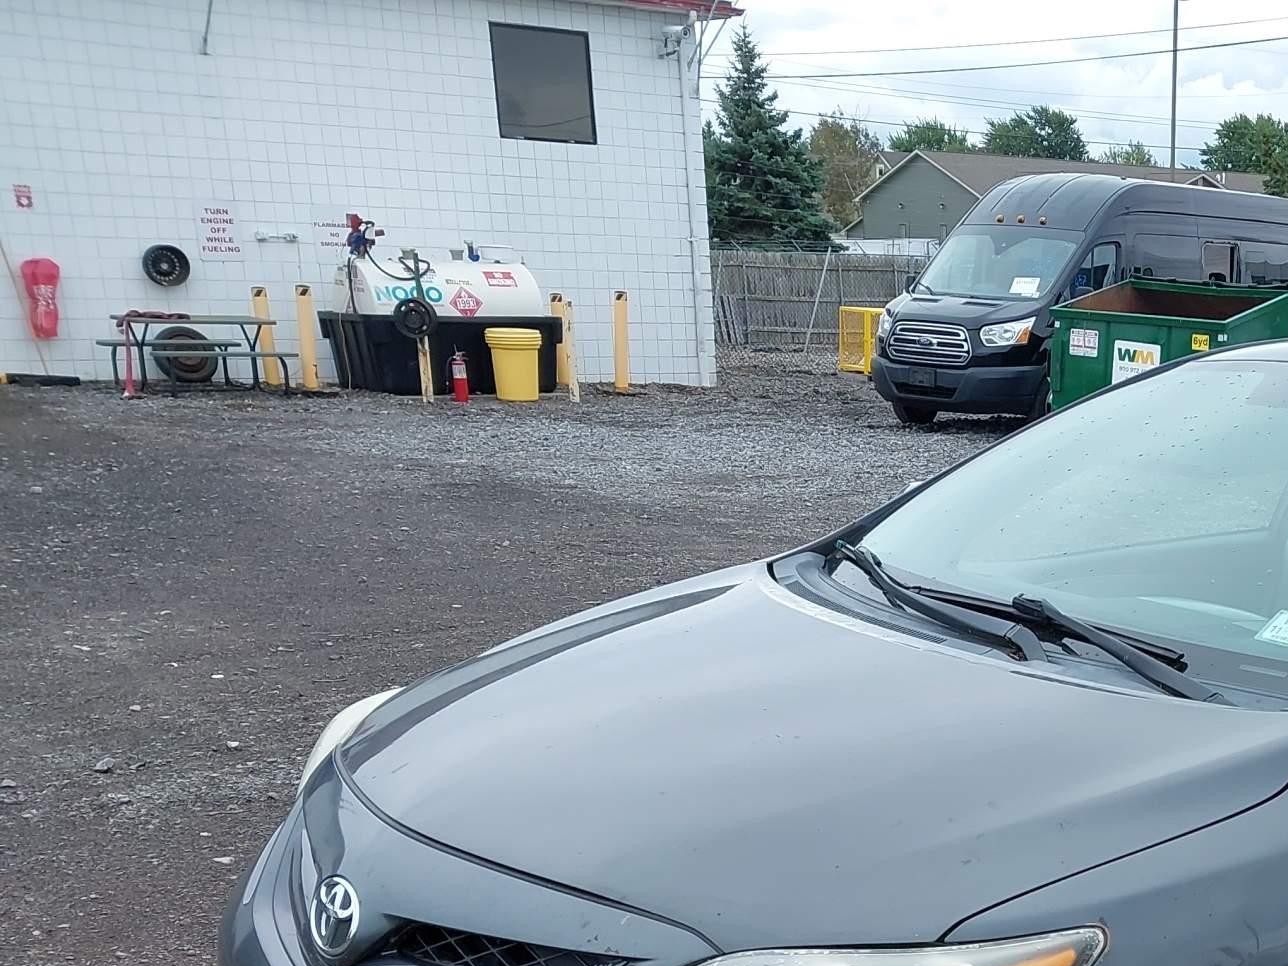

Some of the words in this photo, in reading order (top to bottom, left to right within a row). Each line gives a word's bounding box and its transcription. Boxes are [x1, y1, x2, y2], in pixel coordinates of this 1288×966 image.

[204, 207, 229, 215] TURN
[200, 217, 235, 225] ENGINE
[210, 226, 227, 234] OFF
[205, 236, 234, 244] WHILE
[456, 298, 477, 308] 1993
[1193, 336, 1209, 348] 6yd
[1117, 347, 1155, 366] WM
